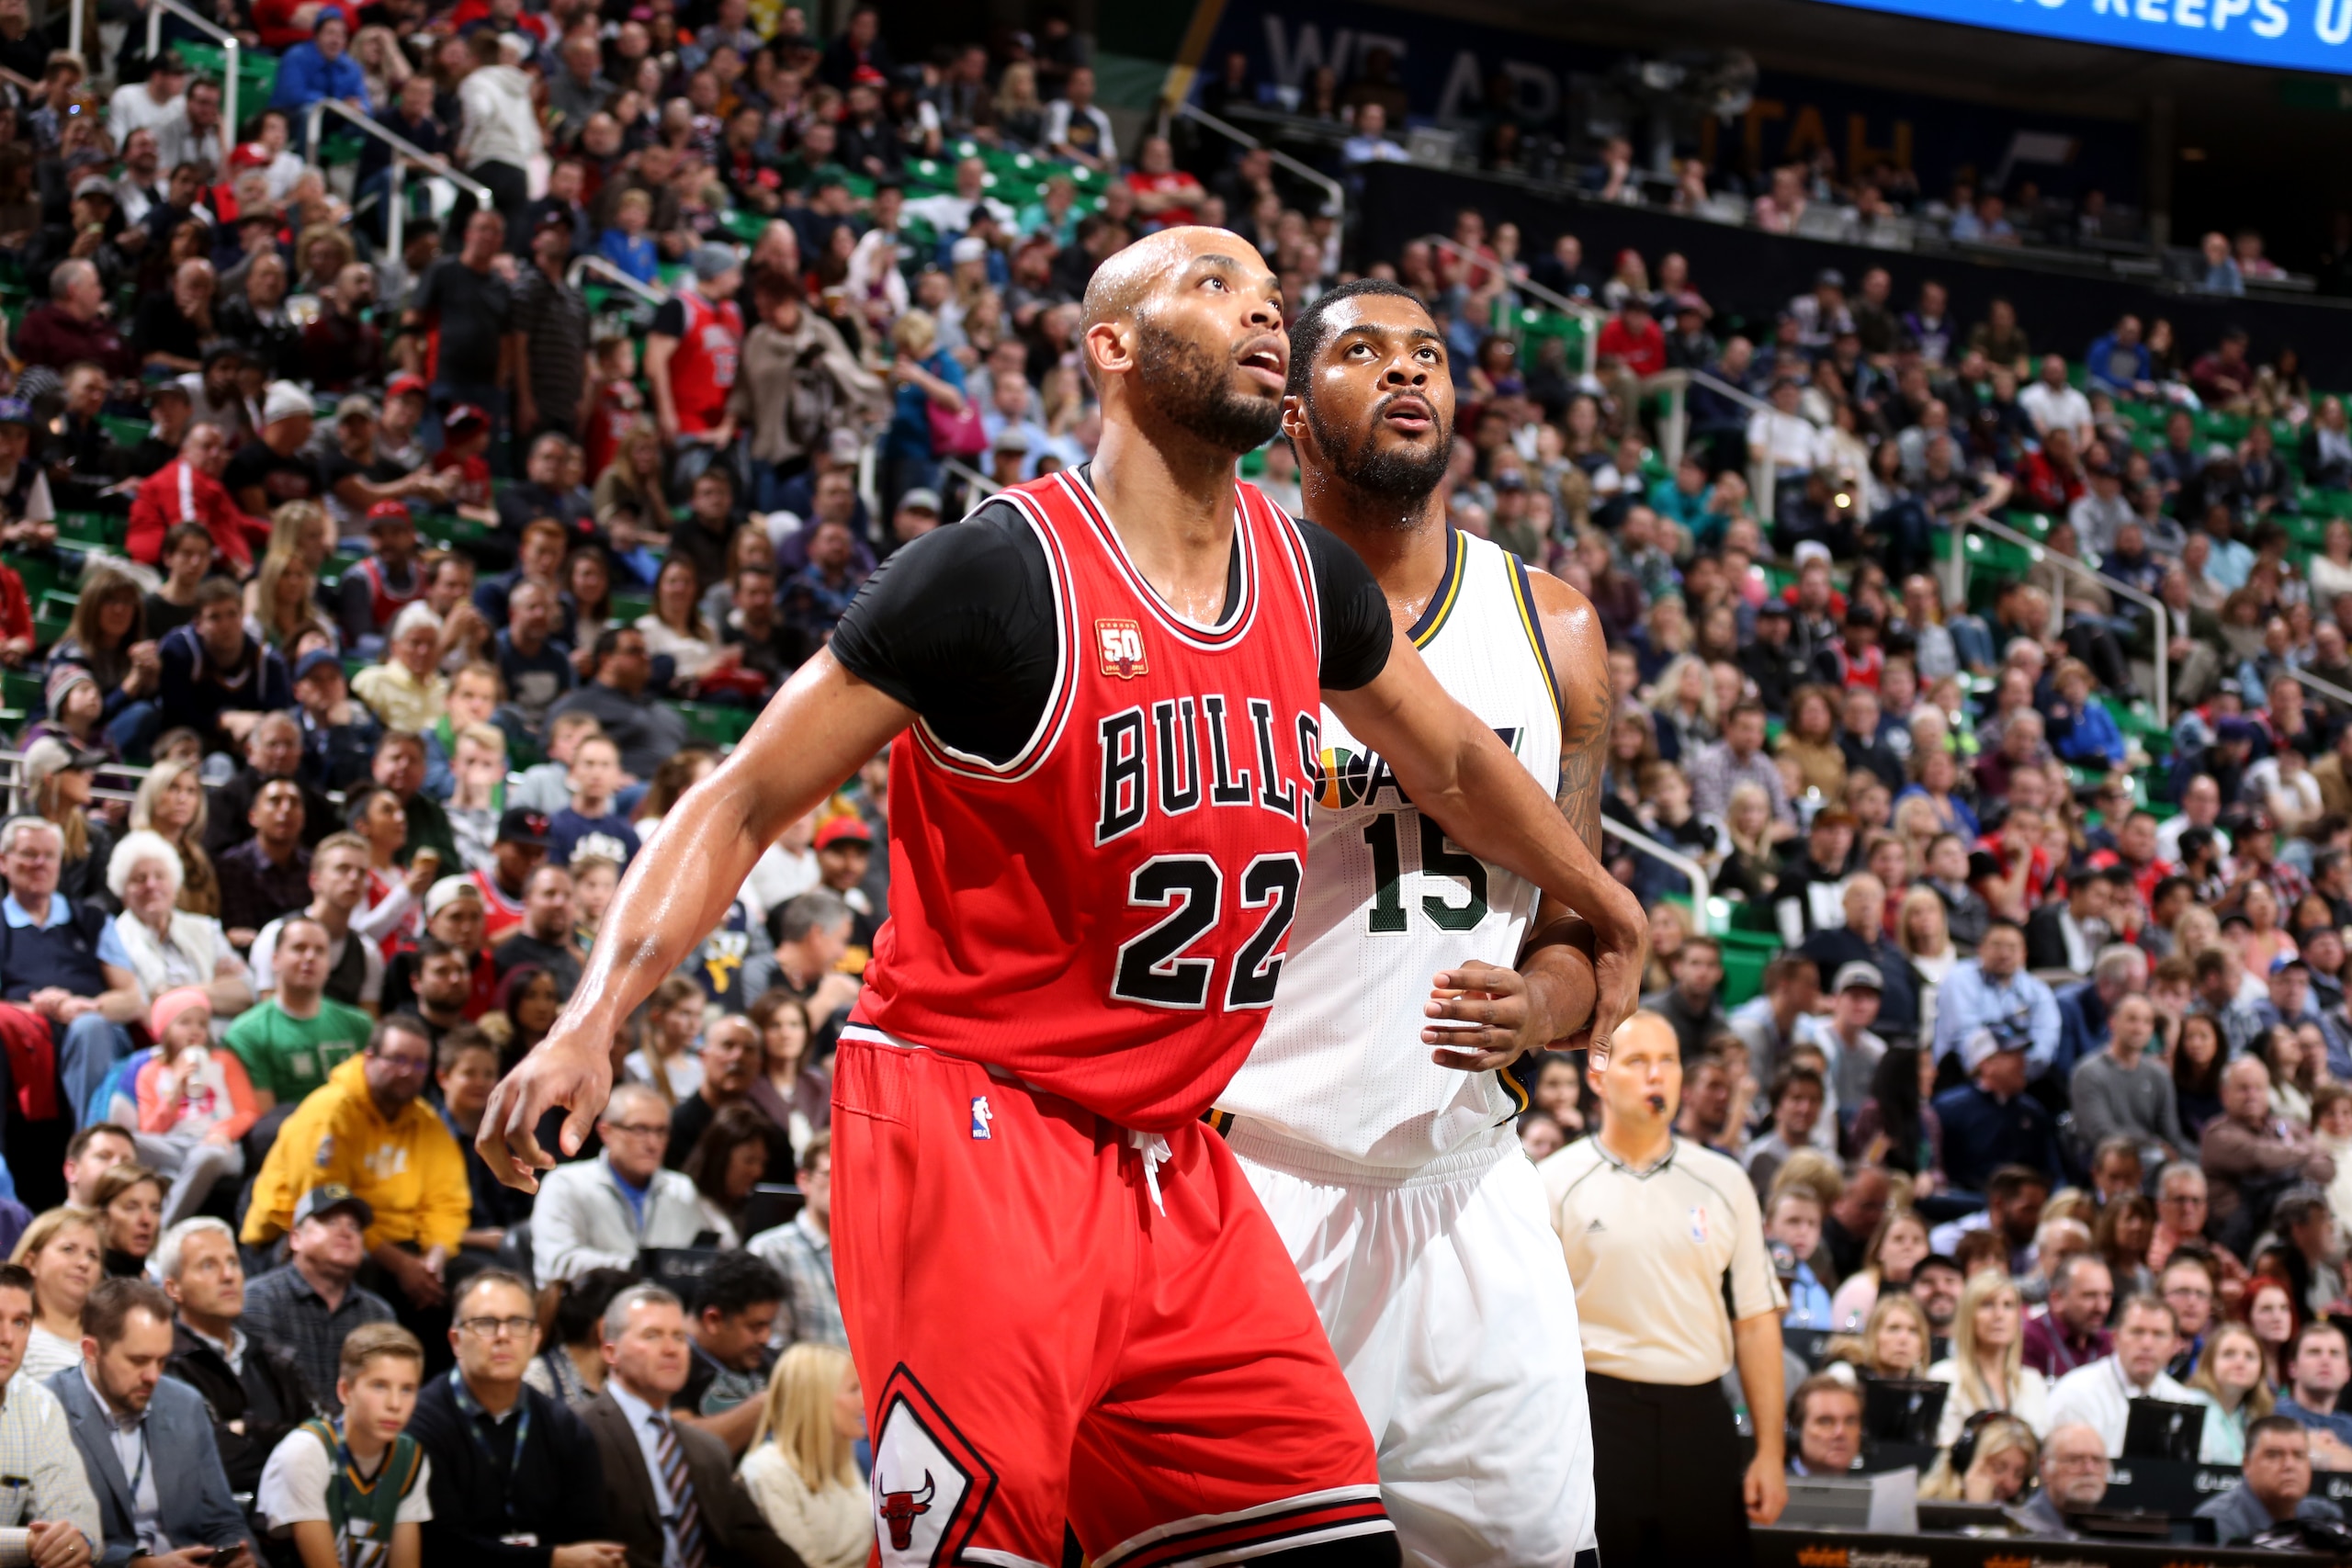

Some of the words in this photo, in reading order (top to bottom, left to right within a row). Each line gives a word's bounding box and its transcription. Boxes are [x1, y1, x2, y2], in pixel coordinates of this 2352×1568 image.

[1100, 628, 1143, 662] 50
[1094, 694, 1320, 847] BULLS
[1110, 852, 1305, 1011] 22
[1363, 810, 1489, 936] 15
[972, 1129, 989, 1138] NBA
